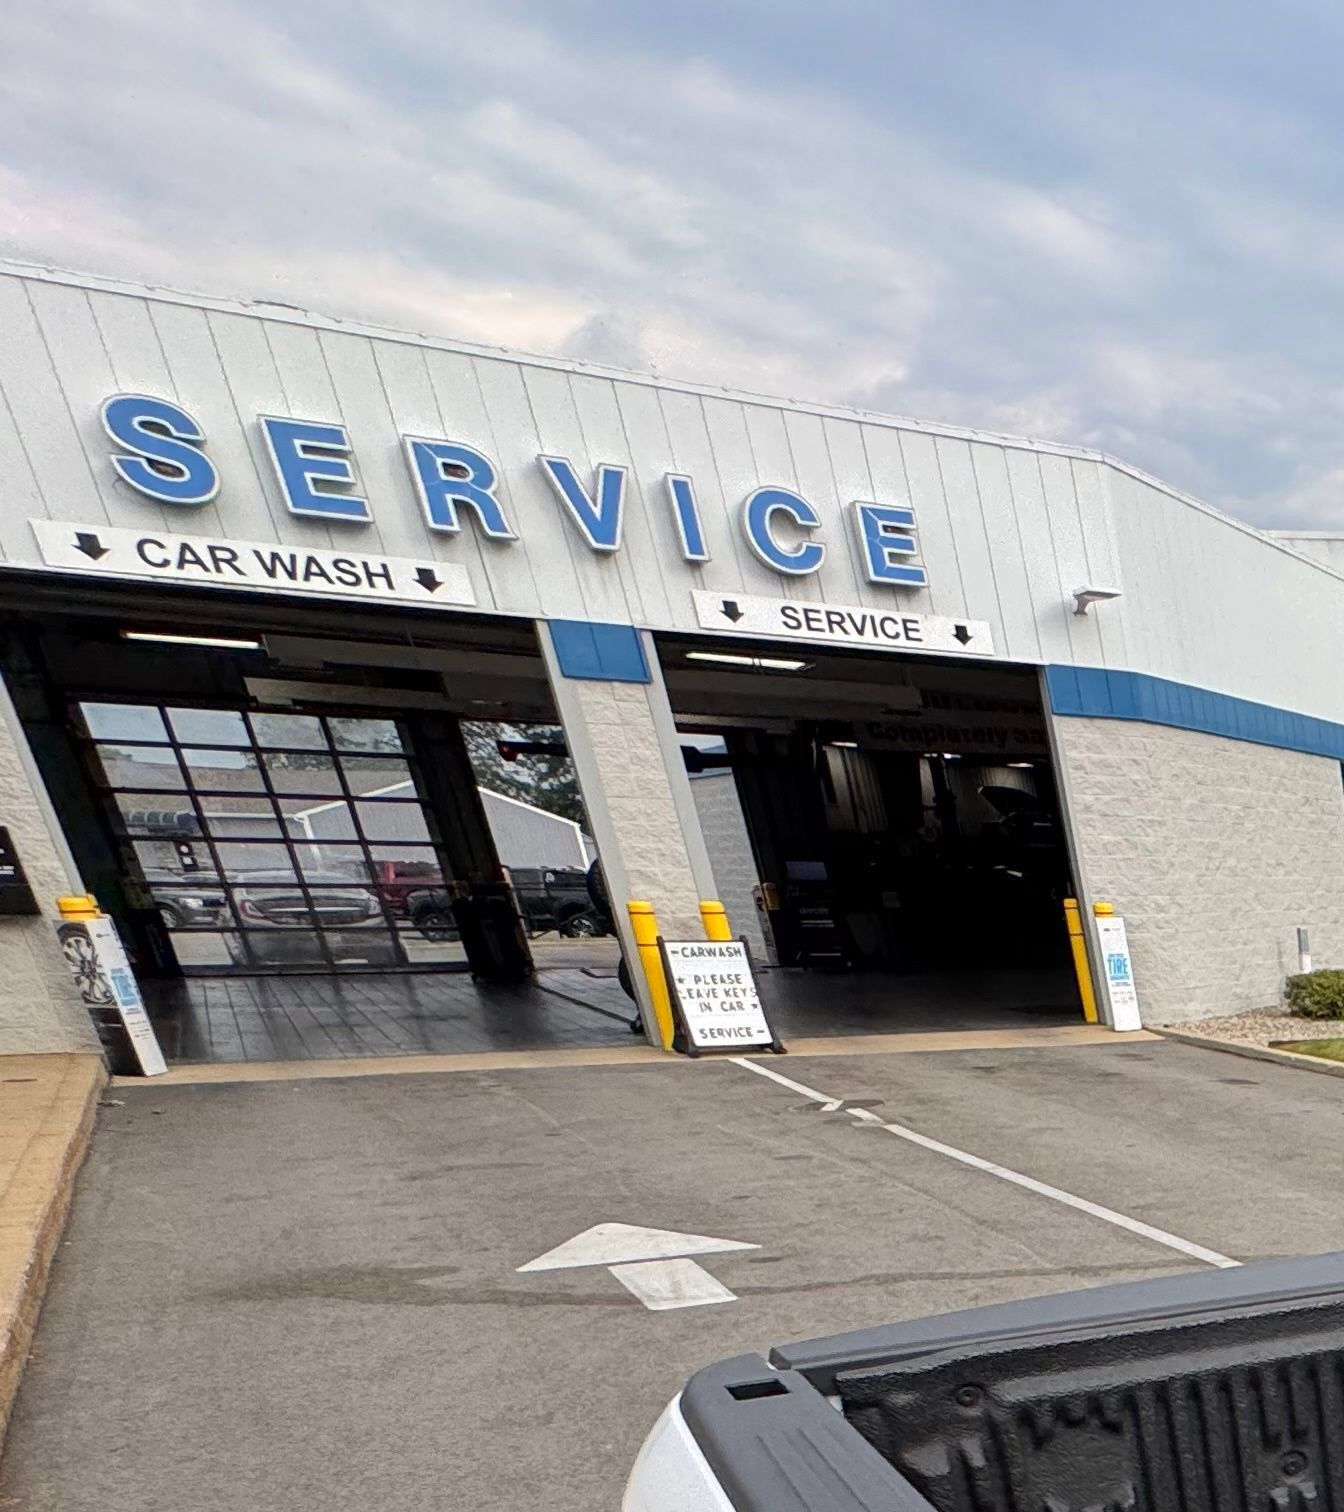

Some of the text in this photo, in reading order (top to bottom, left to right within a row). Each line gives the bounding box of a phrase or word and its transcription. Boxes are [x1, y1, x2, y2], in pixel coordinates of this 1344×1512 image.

[99, 393, 930, 589] SERVICE
[136, 536, 398, 592] CAR WASH
[780, 604, 925, 644] SERVICE
[681, 946, 742, 958] CARWASH
[694, 973, 742, 985] PLEASE
[678, 987, 758, 1000] LEAVE KEYS
[700, 1001, 745, 1013] IN CAR
[699, 1027, 754, 1039] SERVICE
